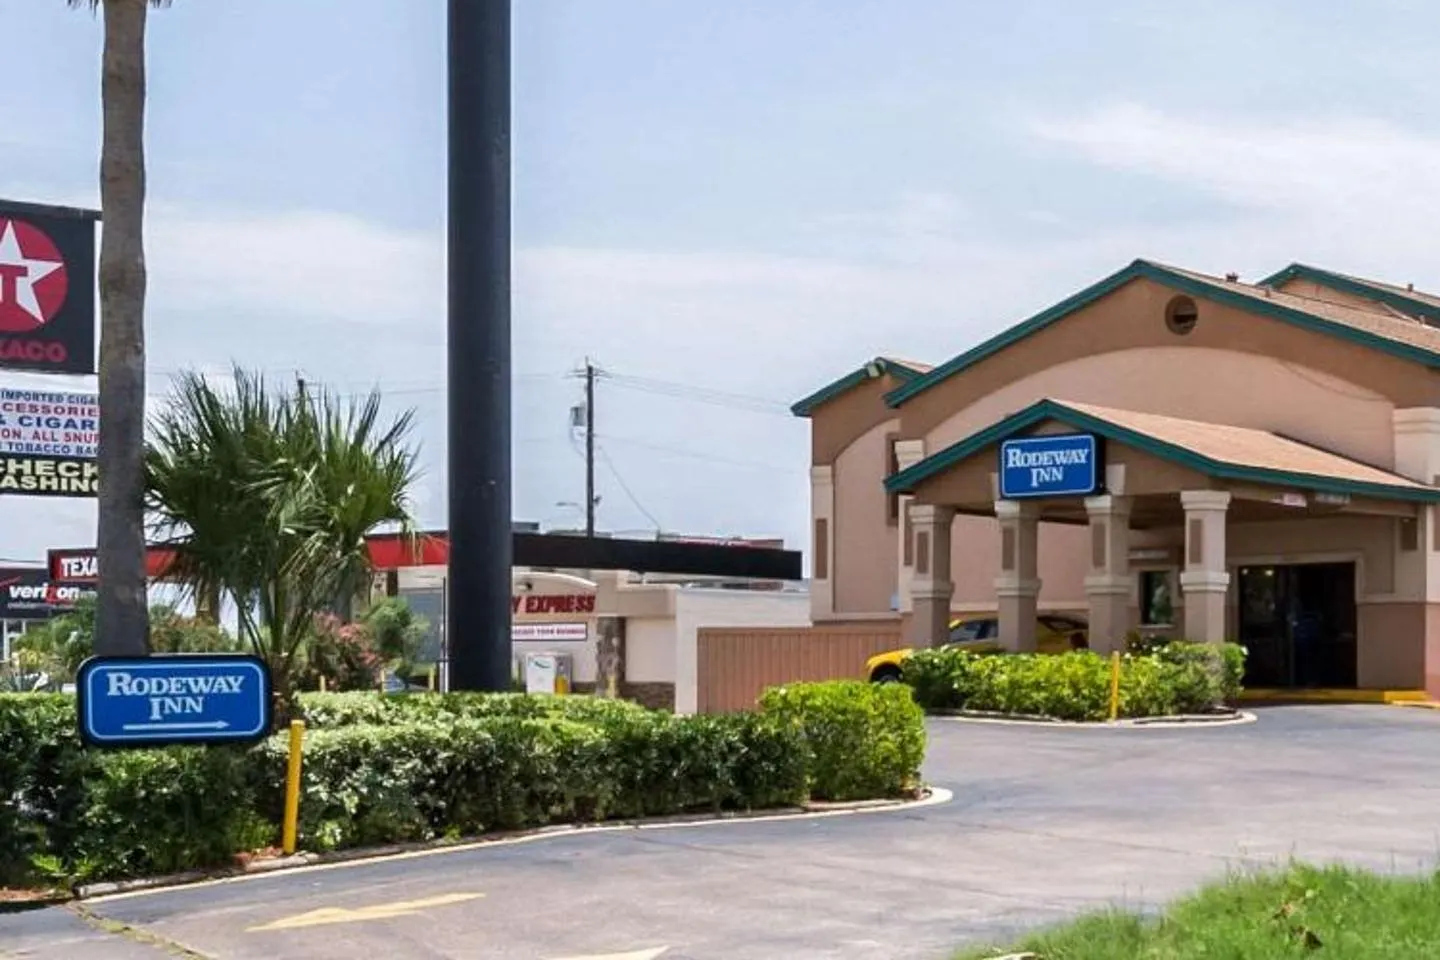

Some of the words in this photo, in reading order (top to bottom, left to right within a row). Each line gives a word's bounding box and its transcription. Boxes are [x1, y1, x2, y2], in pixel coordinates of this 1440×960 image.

[1, 390, 64, 404] IMPORTED
[67, 395, 99, 406] CIGA
[2, 402, 99, 418] CESSORIE
[32, 430, 58, 442] ALL
[8, 441, 71, 454] TOBACCO
[1006, 448, 1090, 469] RODEWAY
[1030, 466, 1064, 488] INN
[9, 582, 80, 604] verizon
[525, 594, 596, 614] EXPRESS
[106, 672, 245, 696] RODEWAY
[149, 696, 204, 721] INN
